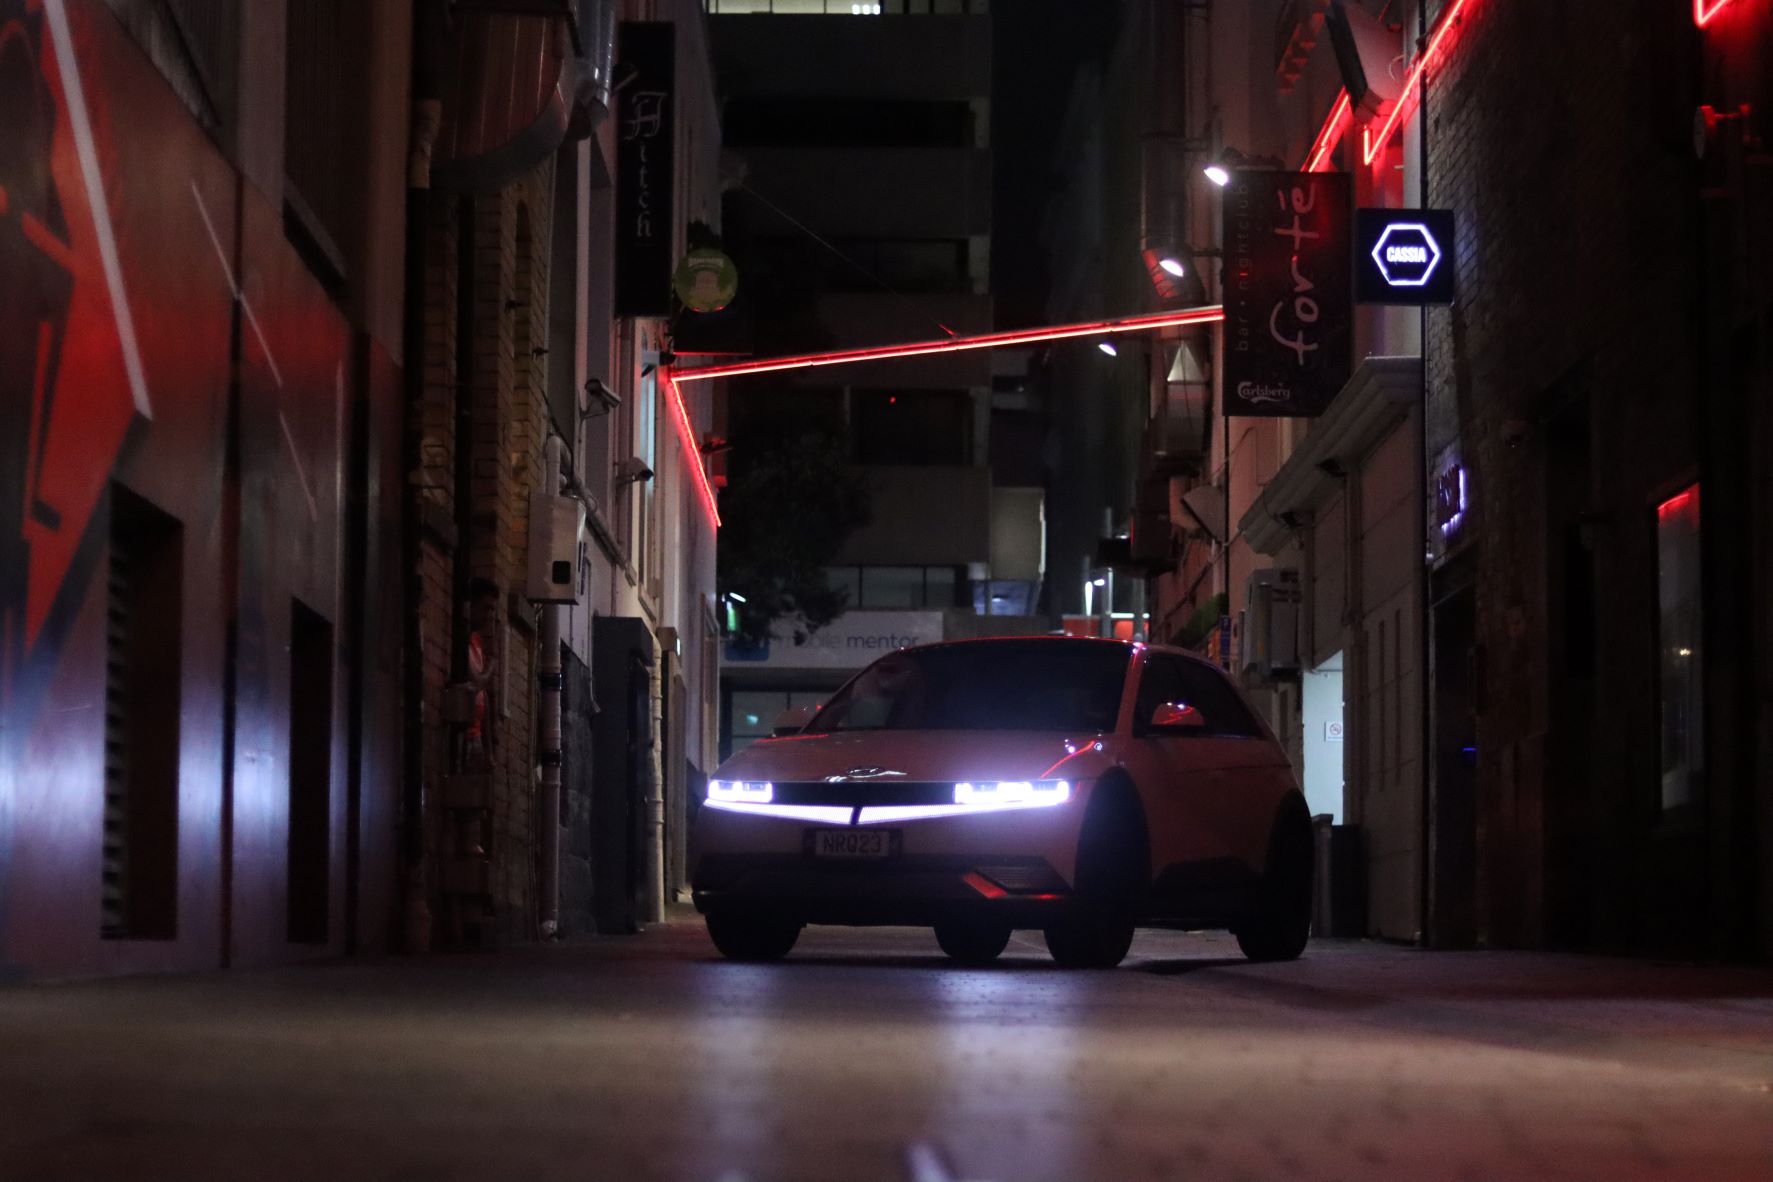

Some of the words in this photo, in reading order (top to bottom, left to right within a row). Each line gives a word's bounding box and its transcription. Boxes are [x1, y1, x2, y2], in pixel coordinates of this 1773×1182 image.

[1235, 183, 1252, 290] nightclub
[1386, 246, 1427, 263] CASSIA
[1235, 314, 1250, 352] bar
[1237, 381, 1291, 404] Carlsberg
[846, 633, 919, 649] mentor
[823, 834, 881, 853] NRQ23
